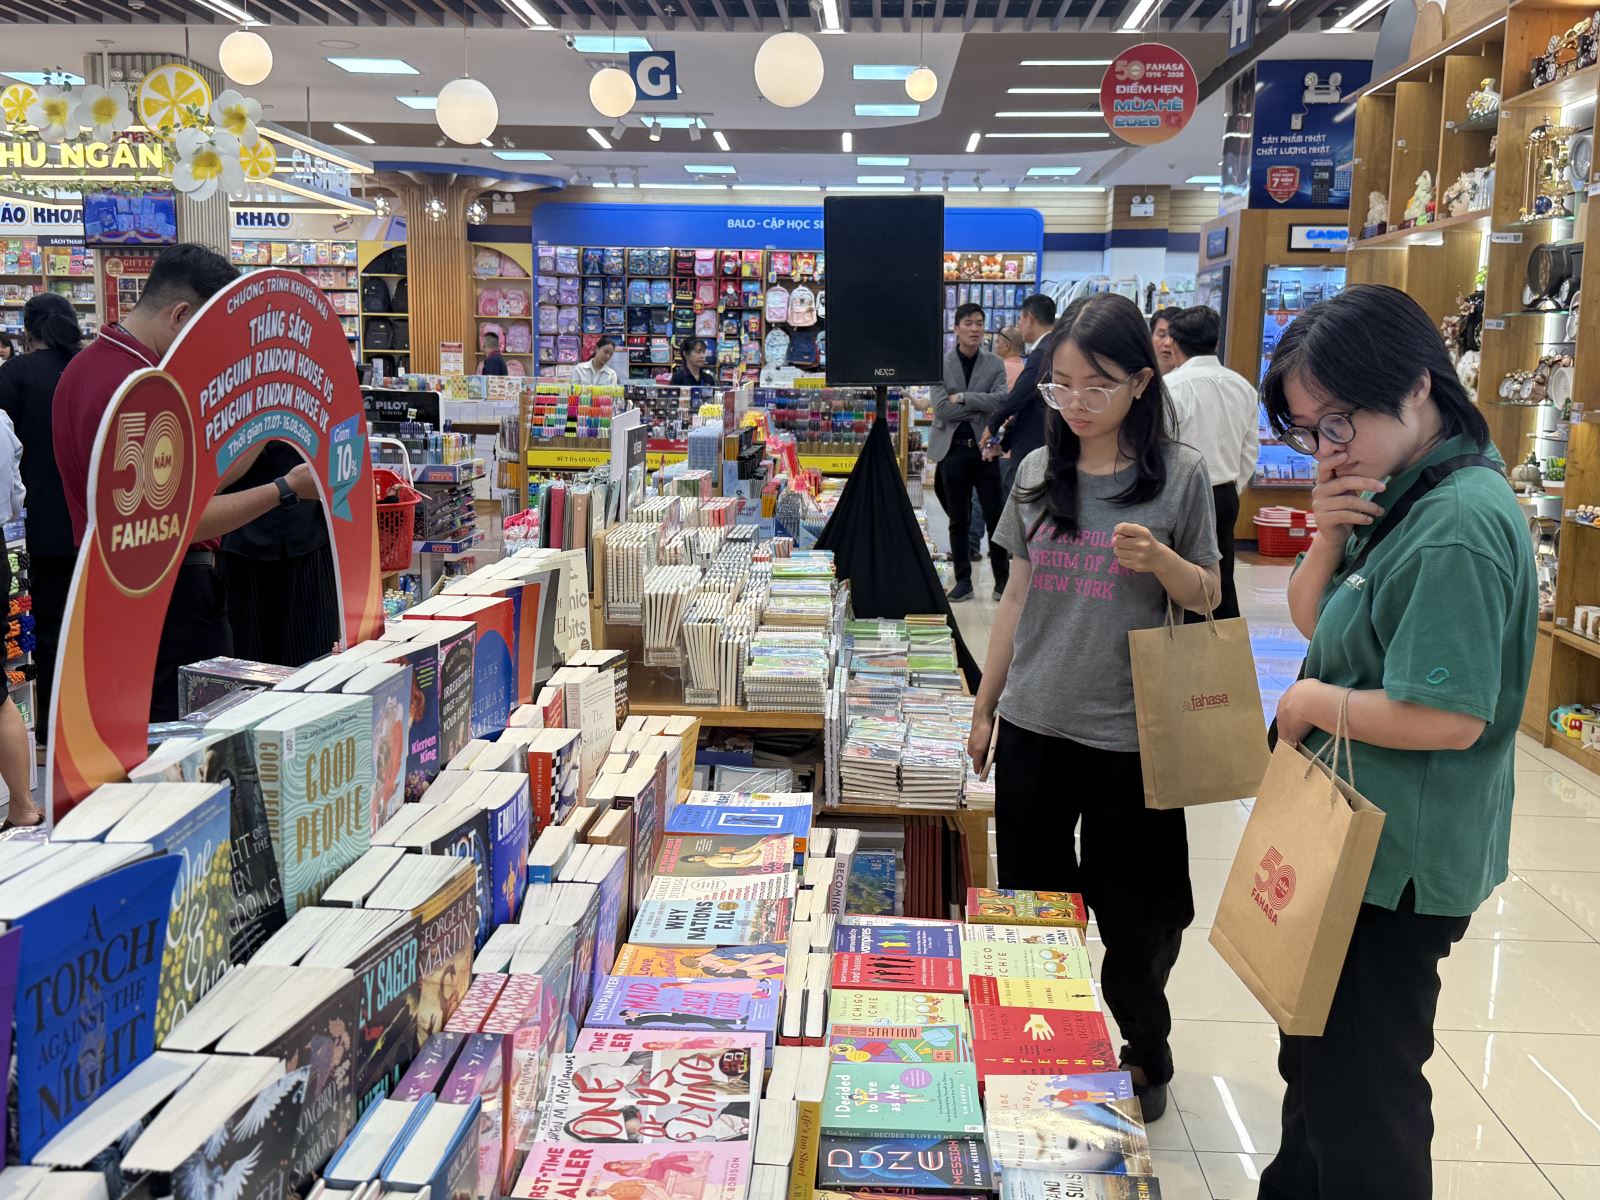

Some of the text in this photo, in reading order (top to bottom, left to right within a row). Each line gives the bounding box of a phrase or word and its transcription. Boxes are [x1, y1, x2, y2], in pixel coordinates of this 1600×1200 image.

[636, 56, 671, 97] G
[1115, 60, 1145, 81] 50
[1146, 63, 1184, 71] FAHASA
[1115, 82, 1184, 96] ĐIỂM HẸN
[1114, 96, 1157, 112] MÙA
[1256, 144, 1331, 156] CHẤT LƯỢNG NHẬT
[1262, 132, 1327, 145] SẢN PHẨM NHẬT
[61, 138, 163, 169] NGÂN
[1, 203, 26, 223] ÁO
[727, 219, 755, 229] BALO
[787, 219, 810, 231] HỌC
[50, 237, 66, 245] SÁCH
[1305, 229, 1349, 240] CASIO
[123, 259, 142, 267] GIFT
[227, 280, 264, 314] CHƯƠNG
[266, 274, 289, 292] TRÌNH
[291, 279, 318, 306] KHUYẾN
[249, 303, 312, 350] THÁNG SÁCH
[200, 348, 334, 418] PENGUIN RANDOM HOUSE US
[874, 368, 895, 377] NEXO
[205, 383, 330, 450] PENGUIN RANDOM HOUSE UK
[376, 402, 408, 411] PILOT
[228, 420, 263, 457] Thời gian
[112, 411, 185, 516] 50
[154, 452, 172, 469] NĂM
[111, 512, 180, 553] FAHASA
[1084, 554, 1105, 573] OF
[1033, 573, 1069, 593] NEW
[479, 662, 499, 683] LAWS
[471, 686, 505, 719] HUMAN
[1191, 691, 1229, 712] fahasa
[443, 714, 457, 733] YOUR
[470, 706, 506, 737] NATURE
[411, 736, 437, 755] Kirsten
[420, 748, 437, 765] King
[306, 736, 356, 803] GOOD
[258, 742, 280, 844] GOOD PEOPLE
[296, 784, 363, 865] PEOPLE
[252, 824, 270, 854] OF THE
[832, 862, 845, 915] BECOMING
[1254, 845, 1297, 911] 50
[665, 908, 688, 931] WHY
[713, 910, 736, 930] FAIL
[1251, 887, 1278, 927] FAHASA
[87, 904, 105, 943] A
[687, 901, 714, 941] NATIONS
[419, 911, 471, 980] MARTIN
[860, 927, 874, 954] vampires
[25, 916, 161, 1035] TORCH
[376, 937, 418, 1013] SAGER
[840, 960, 849, 983] surrounded
[850, 973, 860, 983] bad
[591, 976, 620, 1021] LYNN PAINTER
[621, 983, 662, 1010] MAID
[671, 990, 713, 1015] EACH
[711, 992, 743, 1019] OTHER
[851, 993, 863, 1021] ICHIGO
[868, 997, 878, 1018] ICHIE
[38, 976, 147, 1071] AGAINST THE
[868, 1027, 918, 1038] STATION
[984, 1057, 1105, 1066] INFERNO
[38, 1011, 147, 1140] NIGHT
[635, 1068, 675, 1139] OF US
[674, 1053, 718, 1128] LYING
[835, 1074, 850, 1113] Decided
[866, 1081, 879, 1113] to Live
[885, 1083, 901, 1112] as Me
[572, 1072, 625, 1137] ONE
[800, 1109, 813, 1135] Life's
[799, 1135, 808, 1149] too
[727, 1157, 740, 1192] BORISON
[797, 1150, 808, 1177] Short
[948, 1140, 964, 1185] MESSIAH
[972, 1164, 982, 1186] FRANK
[1065, 1173, 1085, 1198] SUNS
